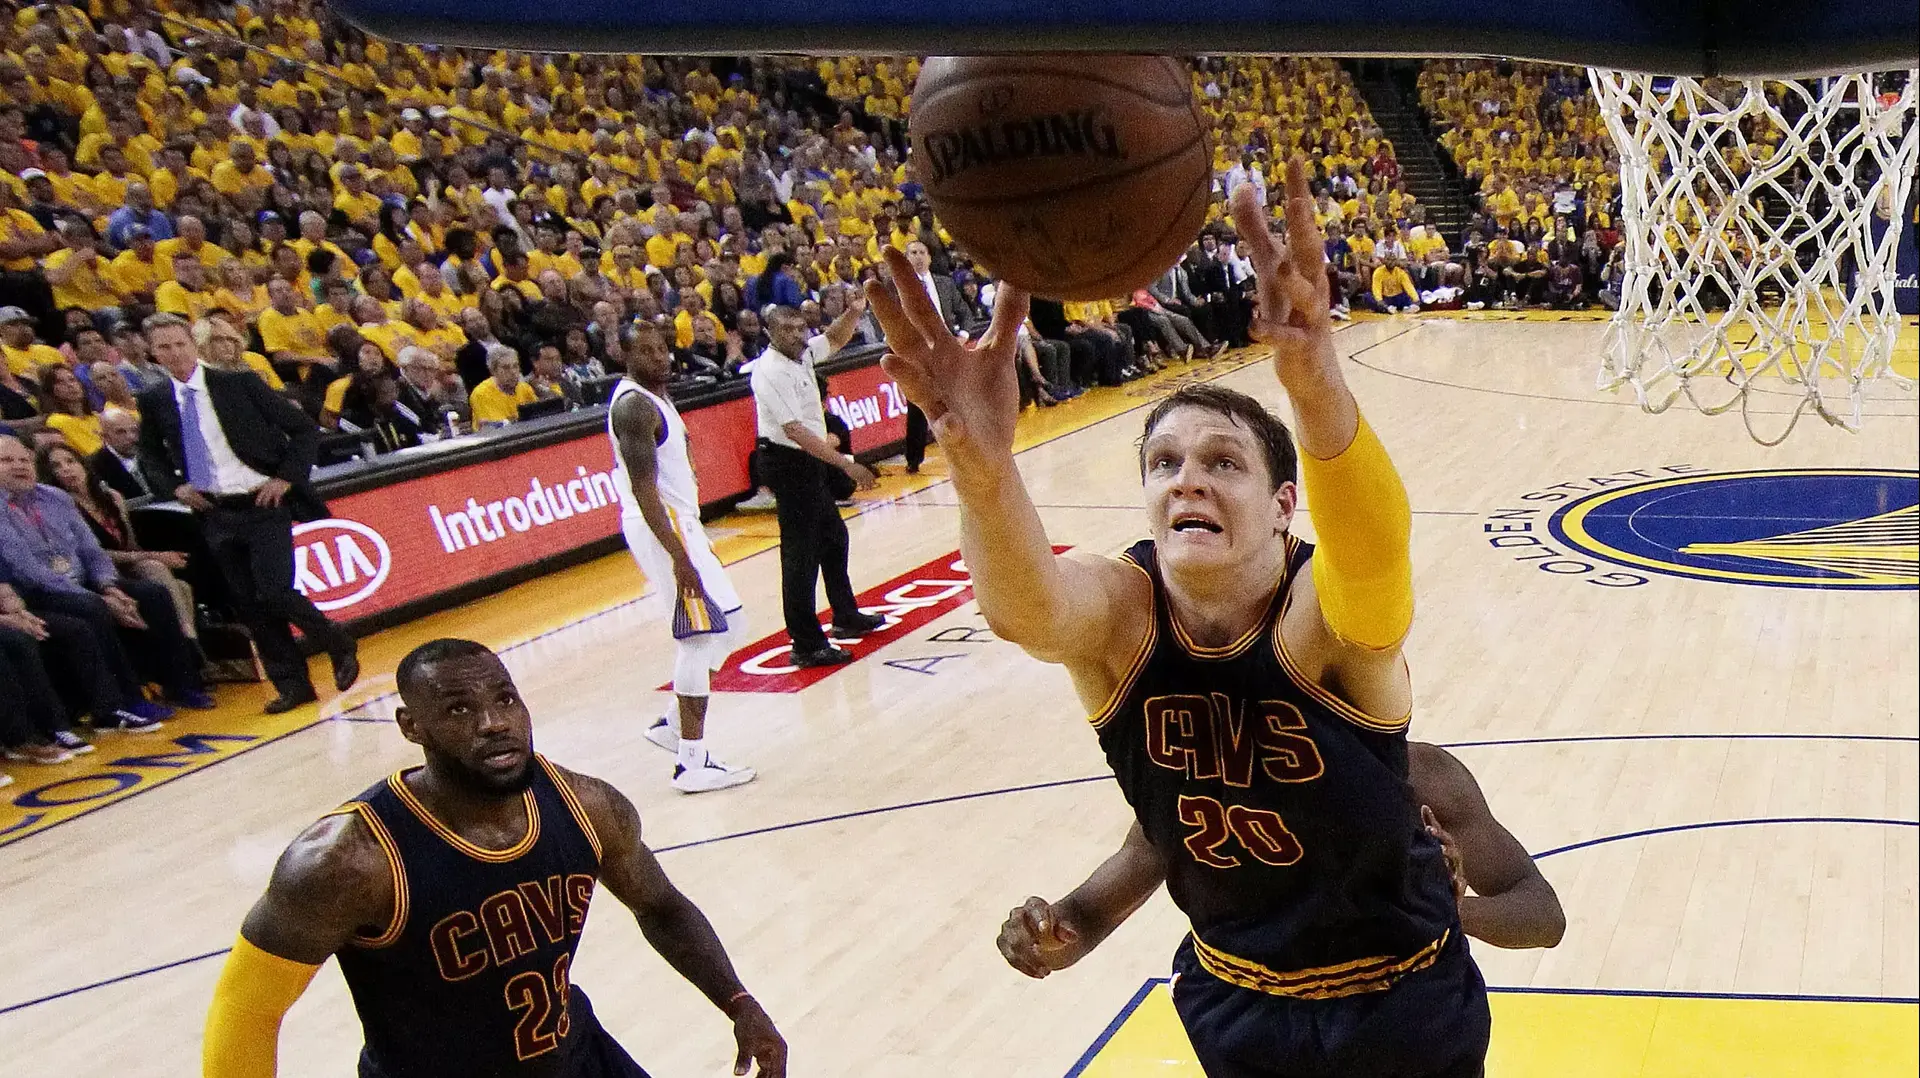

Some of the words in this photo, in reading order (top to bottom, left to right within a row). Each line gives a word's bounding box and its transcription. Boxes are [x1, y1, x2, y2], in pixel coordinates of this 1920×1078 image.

[924, 106, 1127, 187] SPALDING
[826, 394, 881, 431] New
[1521, 463, 1710, 502] STATE
[1484, 507, 1650, 588] GOLDEN
[1143, 691, 1326, 788] CAVS
[1177, 794, 1304, 869] 20
[430, 873, 595, 982] CAVS
